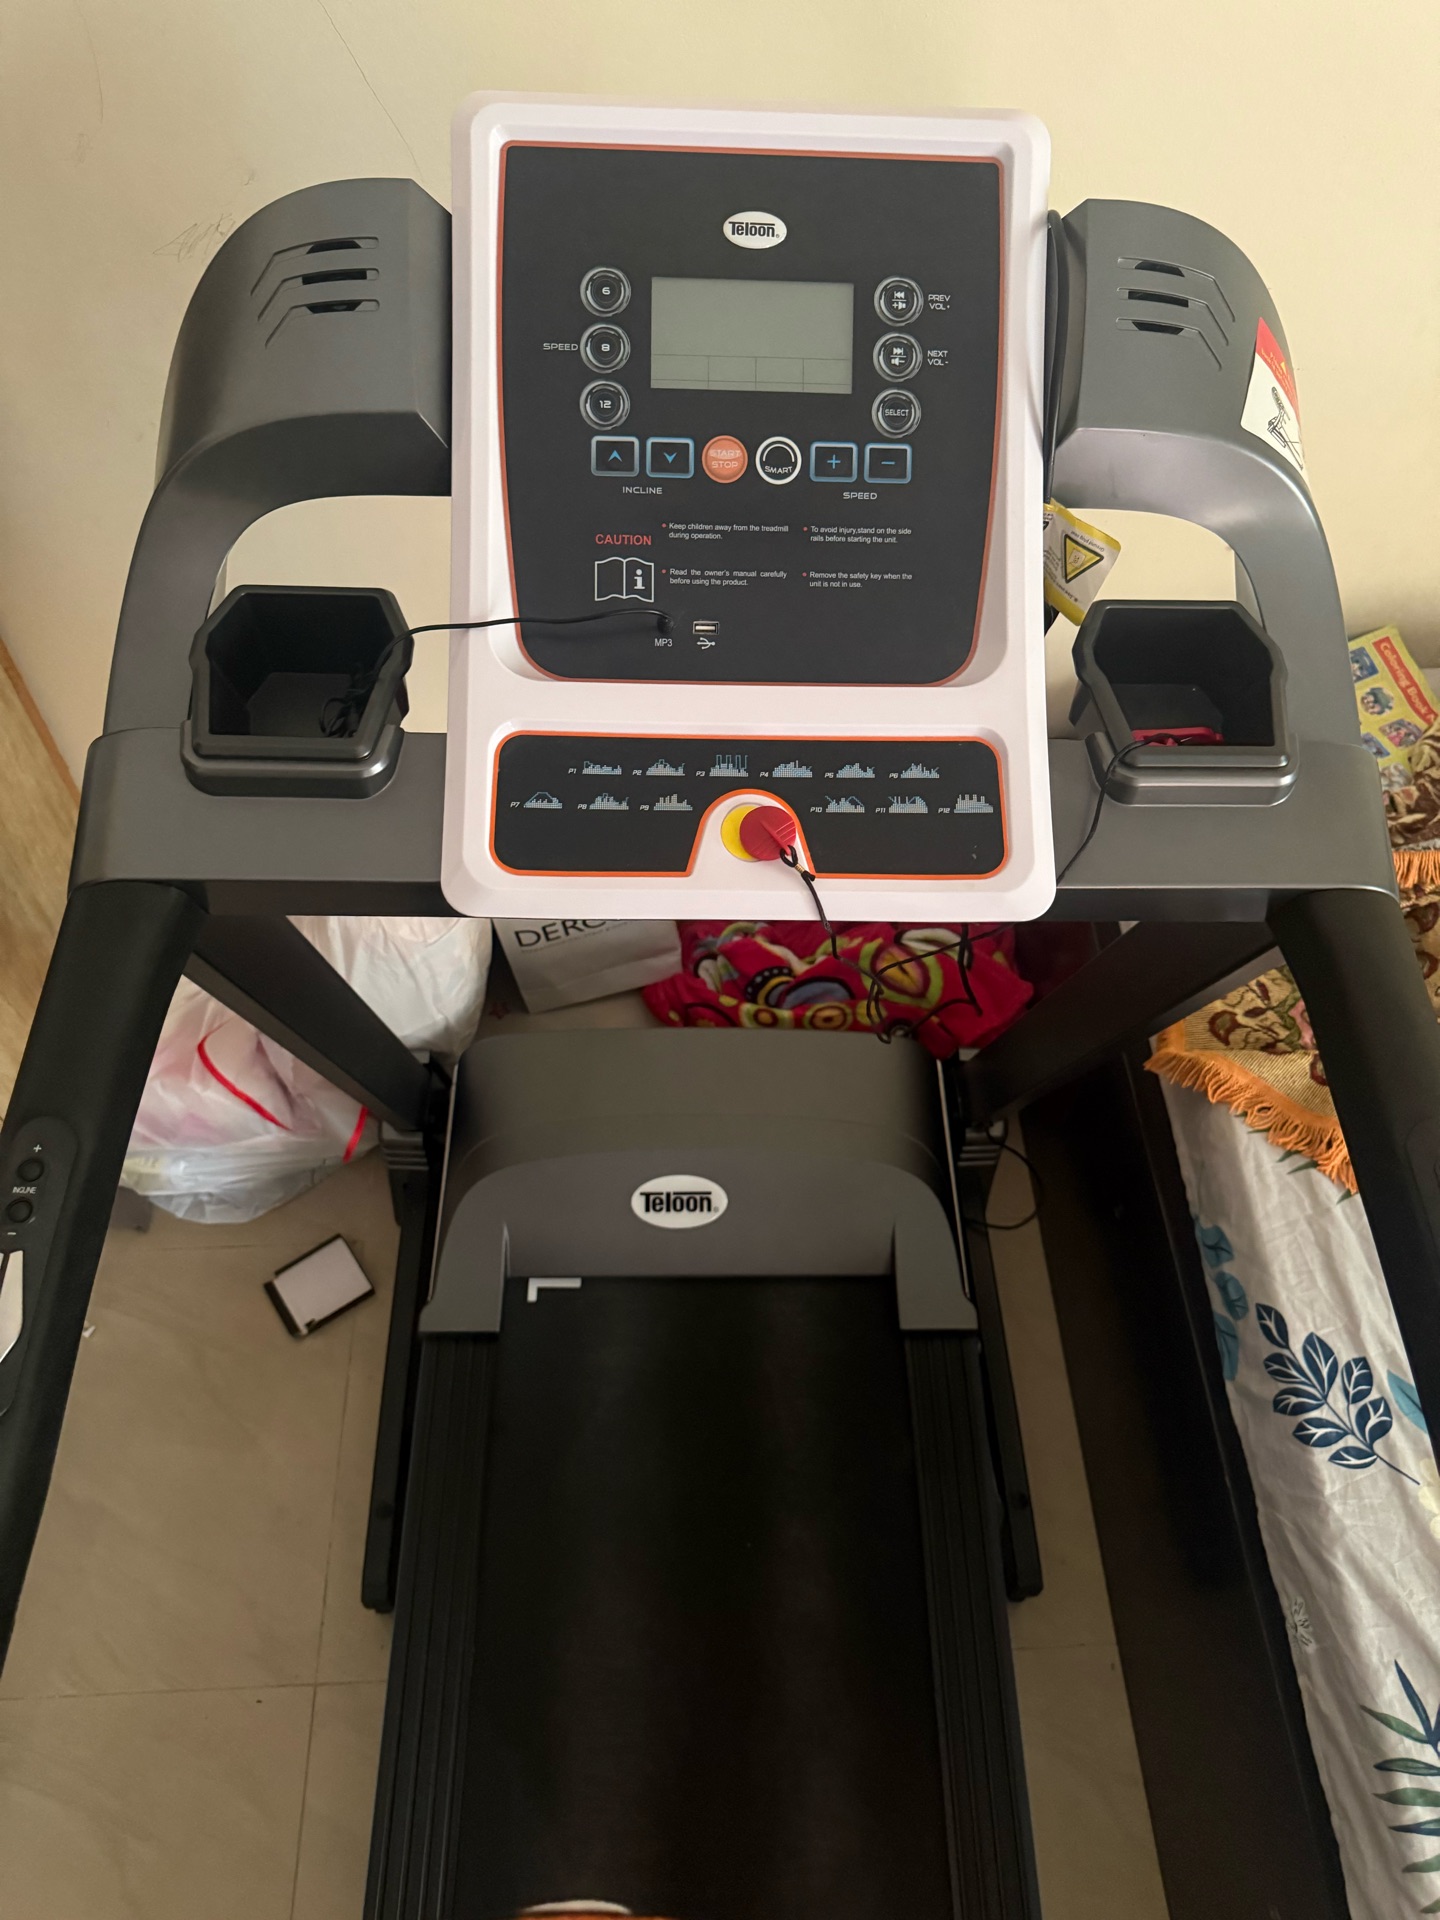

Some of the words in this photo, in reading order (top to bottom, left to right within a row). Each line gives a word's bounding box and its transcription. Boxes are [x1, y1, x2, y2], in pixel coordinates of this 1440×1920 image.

[728, 221, 776, 238] Teloon
[601, 286, 611, 296] 6
[928, 294, 951, 302] PREV
[543, 342, 579, 351] SPEED
[601, 343, 611, 352] 8
[927, 350, 949, 358] NEXT
[599, 400, 612, 409] 12
[885, 408, 909, 417] SELECT
[710, 449, 742, 458] START
[711, 461, 739, 470] STOP
[764, 465, 793, 476] SMART
[622, 486, 663, 495] INCLINE
[843, 491, 878, 501] SPEED
[668, 522, 686, 531] Keep
[687, 523, 714, 531] children
[733, 524, 748, 532] from
[749, 524, 760, 532] the
[761, 525, 789, 533] treadmill
[810, 525, 819, 534] To
[819, 526, 838, 534] avoid
[886, 527, 897, 535] the
[897, 527, 912, 535] side
[595, 533, 652, 546] CAUTION
[668, 531, 690, 540] during
[690, 532, 723, 540] operation.
[825, 535, 846, 543] before
[847, 536, 871, 544] starting
[669, 568, 688, 576] Read
[690, 568, 701, 576] the
[704, 569, 730, 577] owner's
[759, 570, 788, 579] carefully
[809, 571, 837, 579] Remove
[849, 572, 869, 580] safety
[870, 572, 882, 581] key
[883, 572, 901, 580] when
[669, 577, 691, 585] before
[691, 578, 710, 586] using
[710, 578, 721, 586] the
[722, 578, 749, 587] product.
[809, 580, 821, 588] unit
[822, 580, 829, 588] is
[829, 580, 841, 588] not
[654, 638, 673, 647] MP3
[1380, 642, 1410, 689] Coloring
[1407, 686, 1429, 714] Book
[640, 1191, 712, 1213] Teloon
